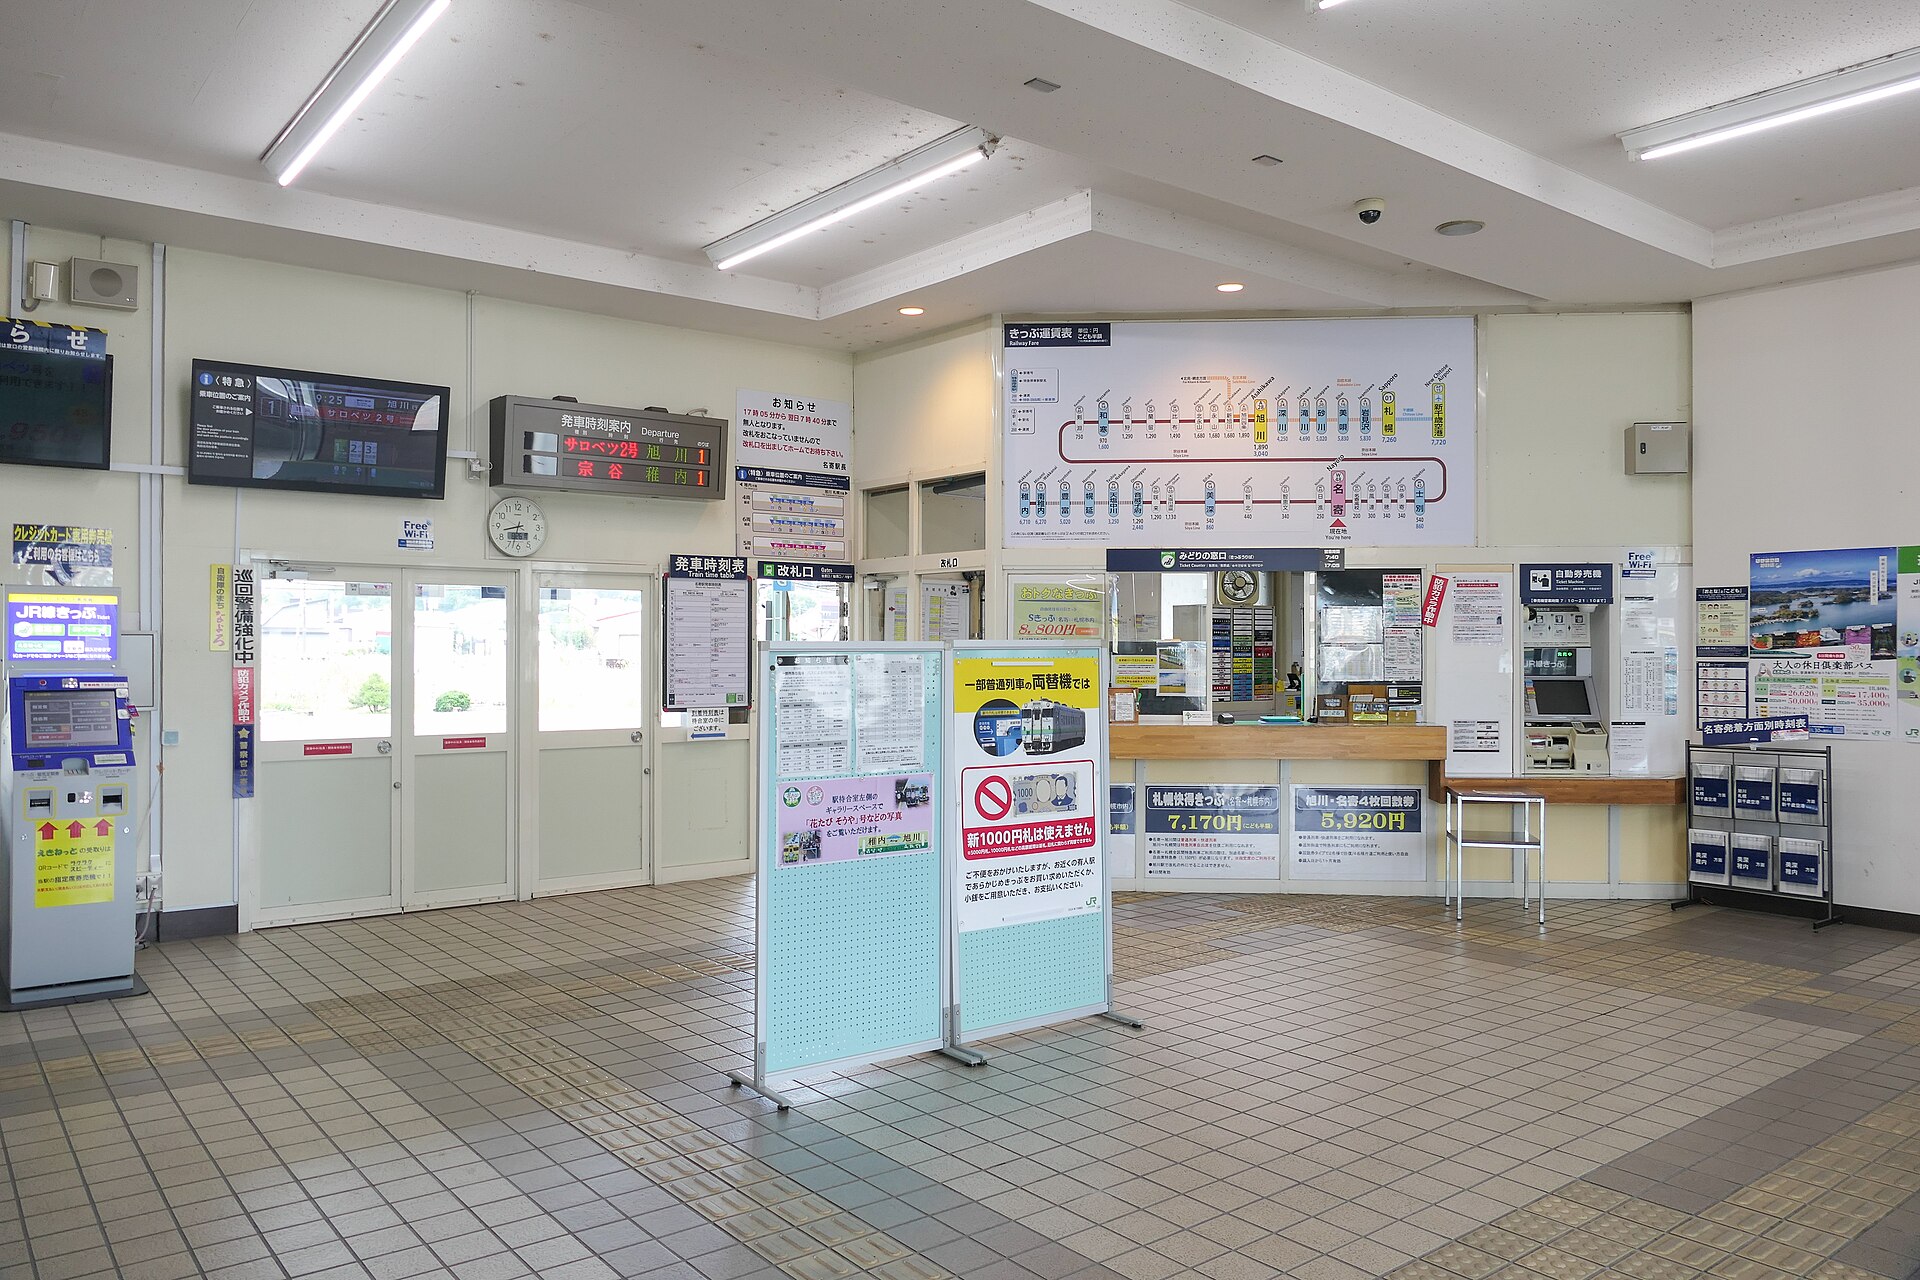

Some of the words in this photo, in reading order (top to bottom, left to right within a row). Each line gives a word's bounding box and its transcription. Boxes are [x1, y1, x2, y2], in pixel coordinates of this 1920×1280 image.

[1009, 327, 1073, 339] きっぷ運賃表
[1437, 367, 1453, 382] Airport
[1250, 376, 1276, 400] Asahikawa
[1378, 373, 1399, 393] Sapporo
[199, 390, 252, 402] 乗車位置のご案内
[316, 394, 343, 405] 9:25
[772, 397, 817, 413] お知らせ
[327, 408, 396, 424] サロベツ2号
[1099, 411, 1108, 433] 和寒
[1278, 409, 1287, 432] 深川
[1317, 409, 1326, 432] 砂川
[1361, 409, 1370, 431] 岩見沢
[1383, 406, 1394, 433] 札幌
[1433, 403, 1443, 437] 新千歳空港
[561, 414, 632, 434] 発車時刻案内
[742, 418, 786, 431] 無人となります。
[1256, 414, 1266, 441] 旭川
[641, 427, 680, 440] Departure
[742, 429, 821, 446] 改札をおこなっていませんので
[564, 437, 638, 459] サロベツ2号
[645, 444, 687, 461] 旭川
[698, 449, 705, 464] 1
[742, 440, 844, 458] 改札口を出ましてホームでお待ち下さい。
[823, 461, 847, 471] 名寄駅長
[1326, 454, 1345, 472] Nayoro
[577, 460, 623, 480] 宗谷
[645, 466, 687, 485] 稚内
[697, 471, 704, 486] 1
[514, 503, 522, 511] 12
[1021, 492, 1029, 515] 稚内
[1037, 492, 1045, 515] 南稚内
[1206, 491, 1214, 513] 美深
[1332, 483, 1344, 516] 名寄
[1415, 490, 1424, 513] 士別
[498, 512, 506, 520] 10
[532, 513, 538, 521] 2
[403, 520, 428, 531] Free
[495, 522, 501, 530] 9
[535, 524, 541, 532] 3
[14, 525, 113, 546] クレジットカード専用券売機
[404, 530, 429, 539] Wi-Fi
[499, 533, 504, 541] 8
[516, 543, 521, 551] 6
[526, 541, 531, 549] 5
[26, 546, 100, 562] ご利用のお客様はこちら
[1179, 551, 1227, 560] みどりの窓口
[1628, 552, 1651, 561] Free
[675, 556, 745, 574] 発車時刻表
[940, 558, 958, 569] 改札口
[1629, 561, 1652, 569] Wi-Fi
[687, 570, 705, 578] Train
[719, 571, 735, 579] table
[777, 565, 814, 578] 改札口
[1555, 569, 1603, 579] 自動券売機
[216, 567, 225, 610] 自衛隊のまち
[1423, 577, 1445, 624] 防犯カメラ作動中
[15, 604, 98, 620] JR線きっぷ
[234, 569, 255, 665] 巡回警備強化中
[1028, 613, 1056, 623] Sきっぷ
[1772, 660, 1874, 671] 大人の休日倶楽部パス
[965, 672, 1091, 692] 一部普通列車の両替機では
[237, 669, 250, 723] 防犯カメラ作動中
[1703, 718, 1807, 736] 名寄発着方面別時刻表
[1905, 728, 1920, 737] JR
[831, 793, 879, 804] 駅待合室左側の
[1017, 788, 1033, 798] 1000
[1152, 792, 1226, 807] 札幌快得きっぷ
[1305, 794, 1415, 808] 旭川・名寄4枚回数券
[825, 803, 884, 815] ギャラリースペースで
[835, 811, 903, 826] そうや」号などの写真
[1167, 814, 1242, 831] 7,170円
[1320, 811, 1406, 831] 5,920円
[826, 825, 882, 838] をご覧いただけます。
[966, 822, 1093, 848] 新1000円札は使えません
[868, 836, 887, 846] 稚内
[902, 833, 921, 842] 旭川
[37, 847, 78, 858] えきねっと
[965, 856, 1096, 880] ご不便をおかけいたしますが、お近くの有人駅
[1695, 858, 1708, 866] 稚内
[965, 868, 1095, 891] であらかじめきっぷをお買い求めいただくか、
[1785, 868, 1799, 876] 稚内
[964, 880, 1084, 903] 小銭をご用意いただき、お支払いください。
[1085, 896, 1098, 906] JR
